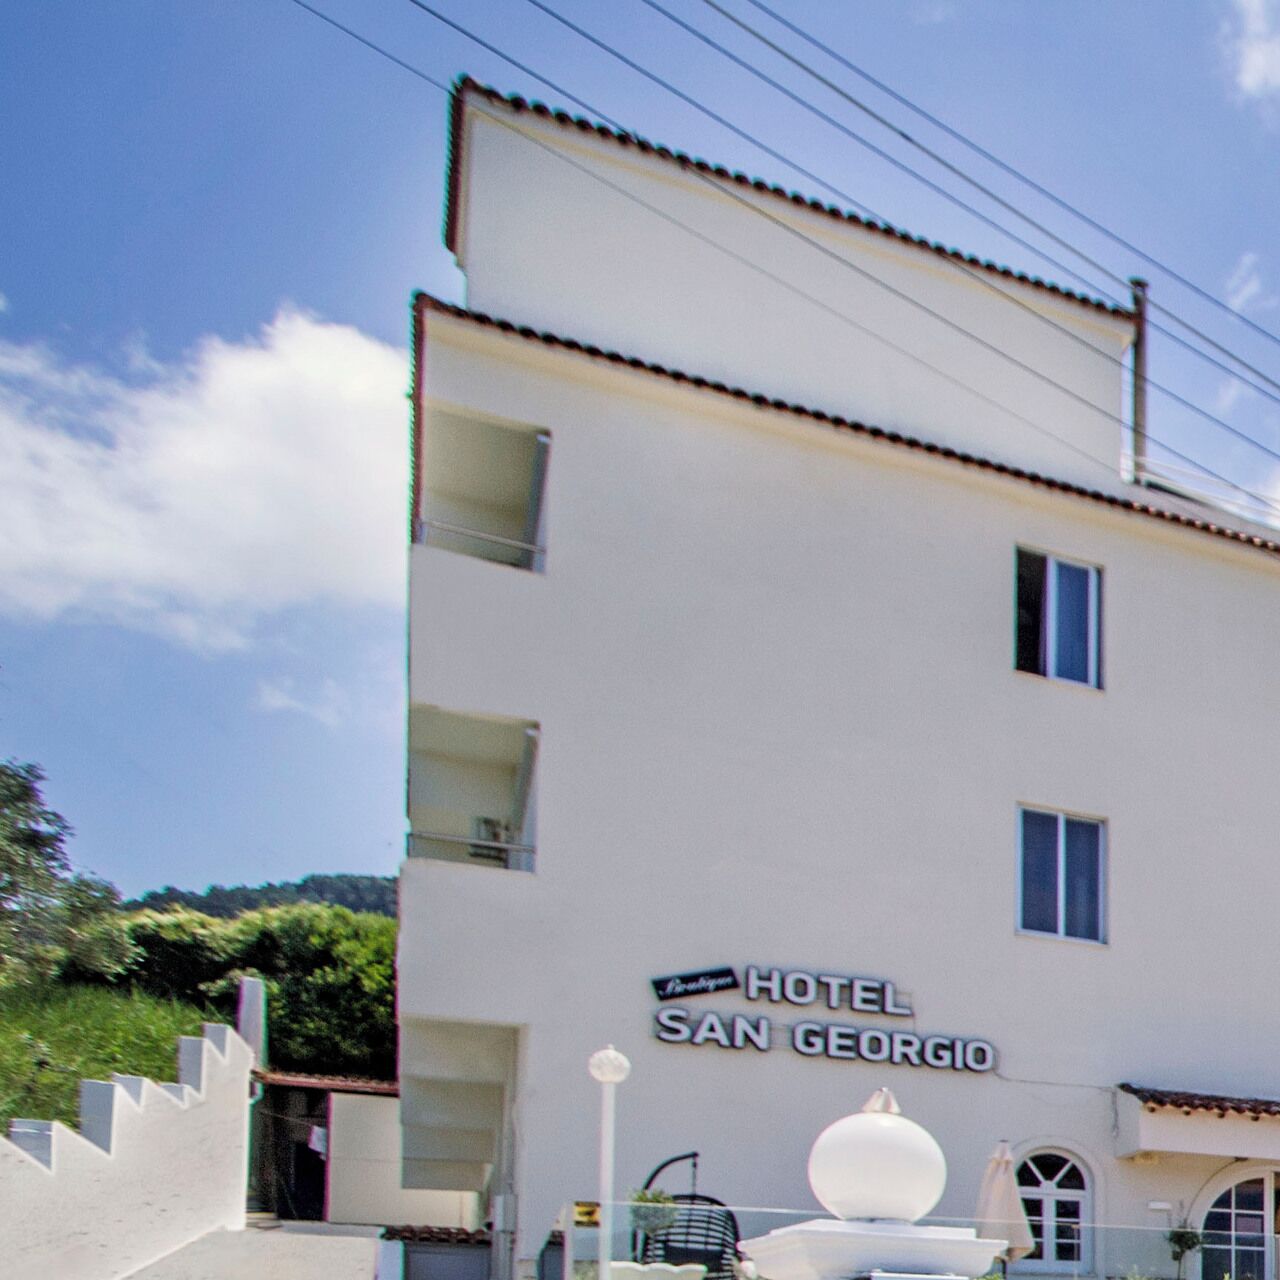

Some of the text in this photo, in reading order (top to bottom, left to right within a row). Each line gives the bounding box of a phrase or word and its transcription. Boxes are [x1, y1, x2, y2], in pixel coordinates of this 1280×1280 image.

[745, 965, 913, 1016] HOTEL
[655, 1007, 994, 1073] SAN GEORGIO
